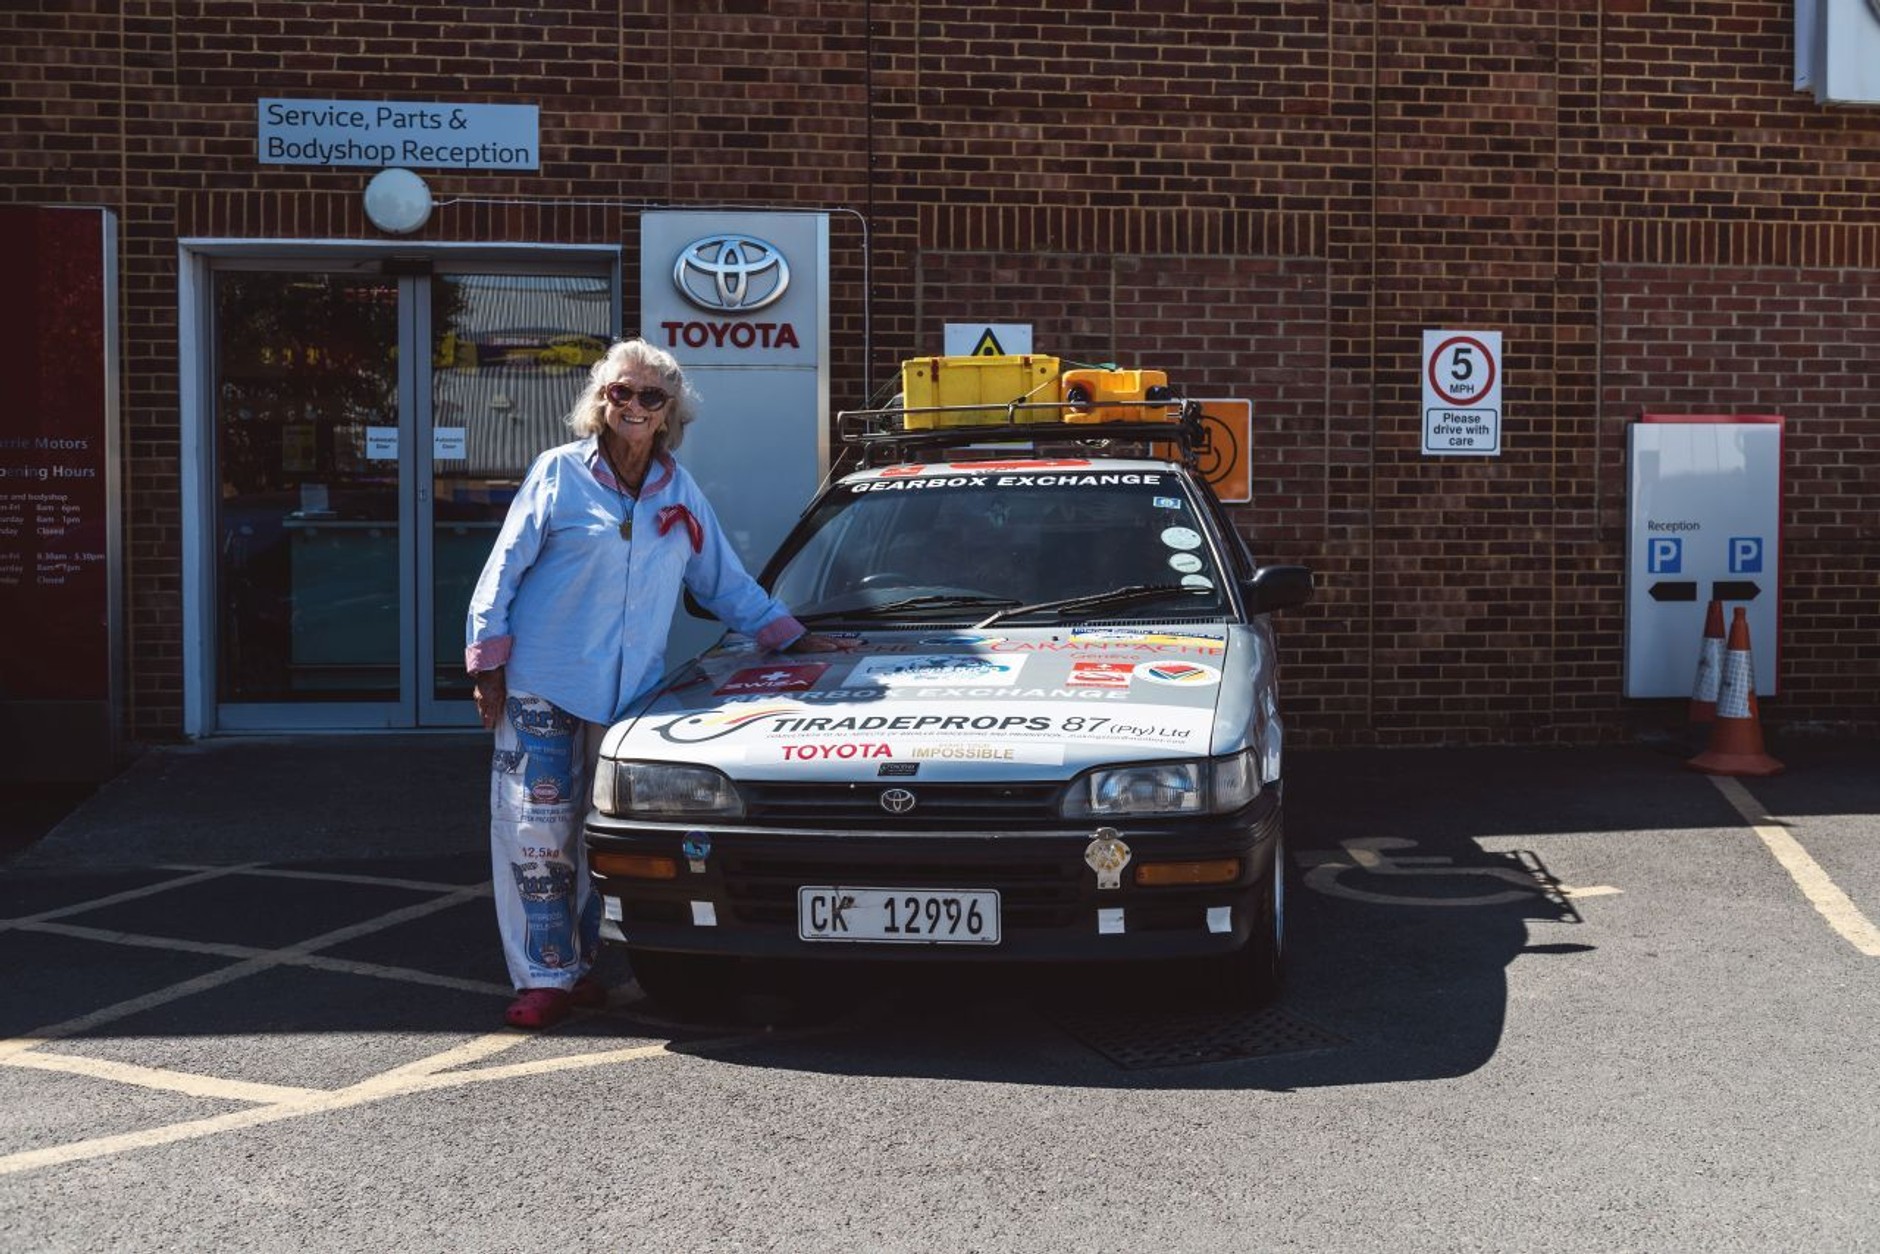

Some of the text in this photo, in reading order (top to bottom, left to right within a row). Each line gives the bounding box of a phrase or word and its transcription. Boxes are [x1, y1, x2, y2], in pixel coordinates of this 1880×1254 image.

[267, 104, 467, 131] Service, Parts &
[268, 137, 529, 167] Bodyshop Reception
[661, 322, 799, 348] TOYOTA
[1451, 348, 1472, 381] 5
[1449, 384, 1474, 394] MPH
[1443, 413, 1481, 424] Please
[1434, 425, 1489, 435] drive with
[35, 437, 88, 450] Motors
[1449, 437, 1474, 446] care
[53, 465, 95, 478] Hours
[851, 474, 1161, 493] GEARBOX EXCHANGE
[1648, 521, 1700, 533] Reception
[1653, 540, 1758, 572] P P
[990, 641, 1108, 652] CARAN
[916, 688, 1131, 699] EXCHANGE
[772, 716, 1192, 738] TIRADEPROPS 87 (Pty) Ltd
[782, 743, 1016, 760] TOYOTA IMPOSSIBLE
[811, 895, 983, 935] CK 12996
